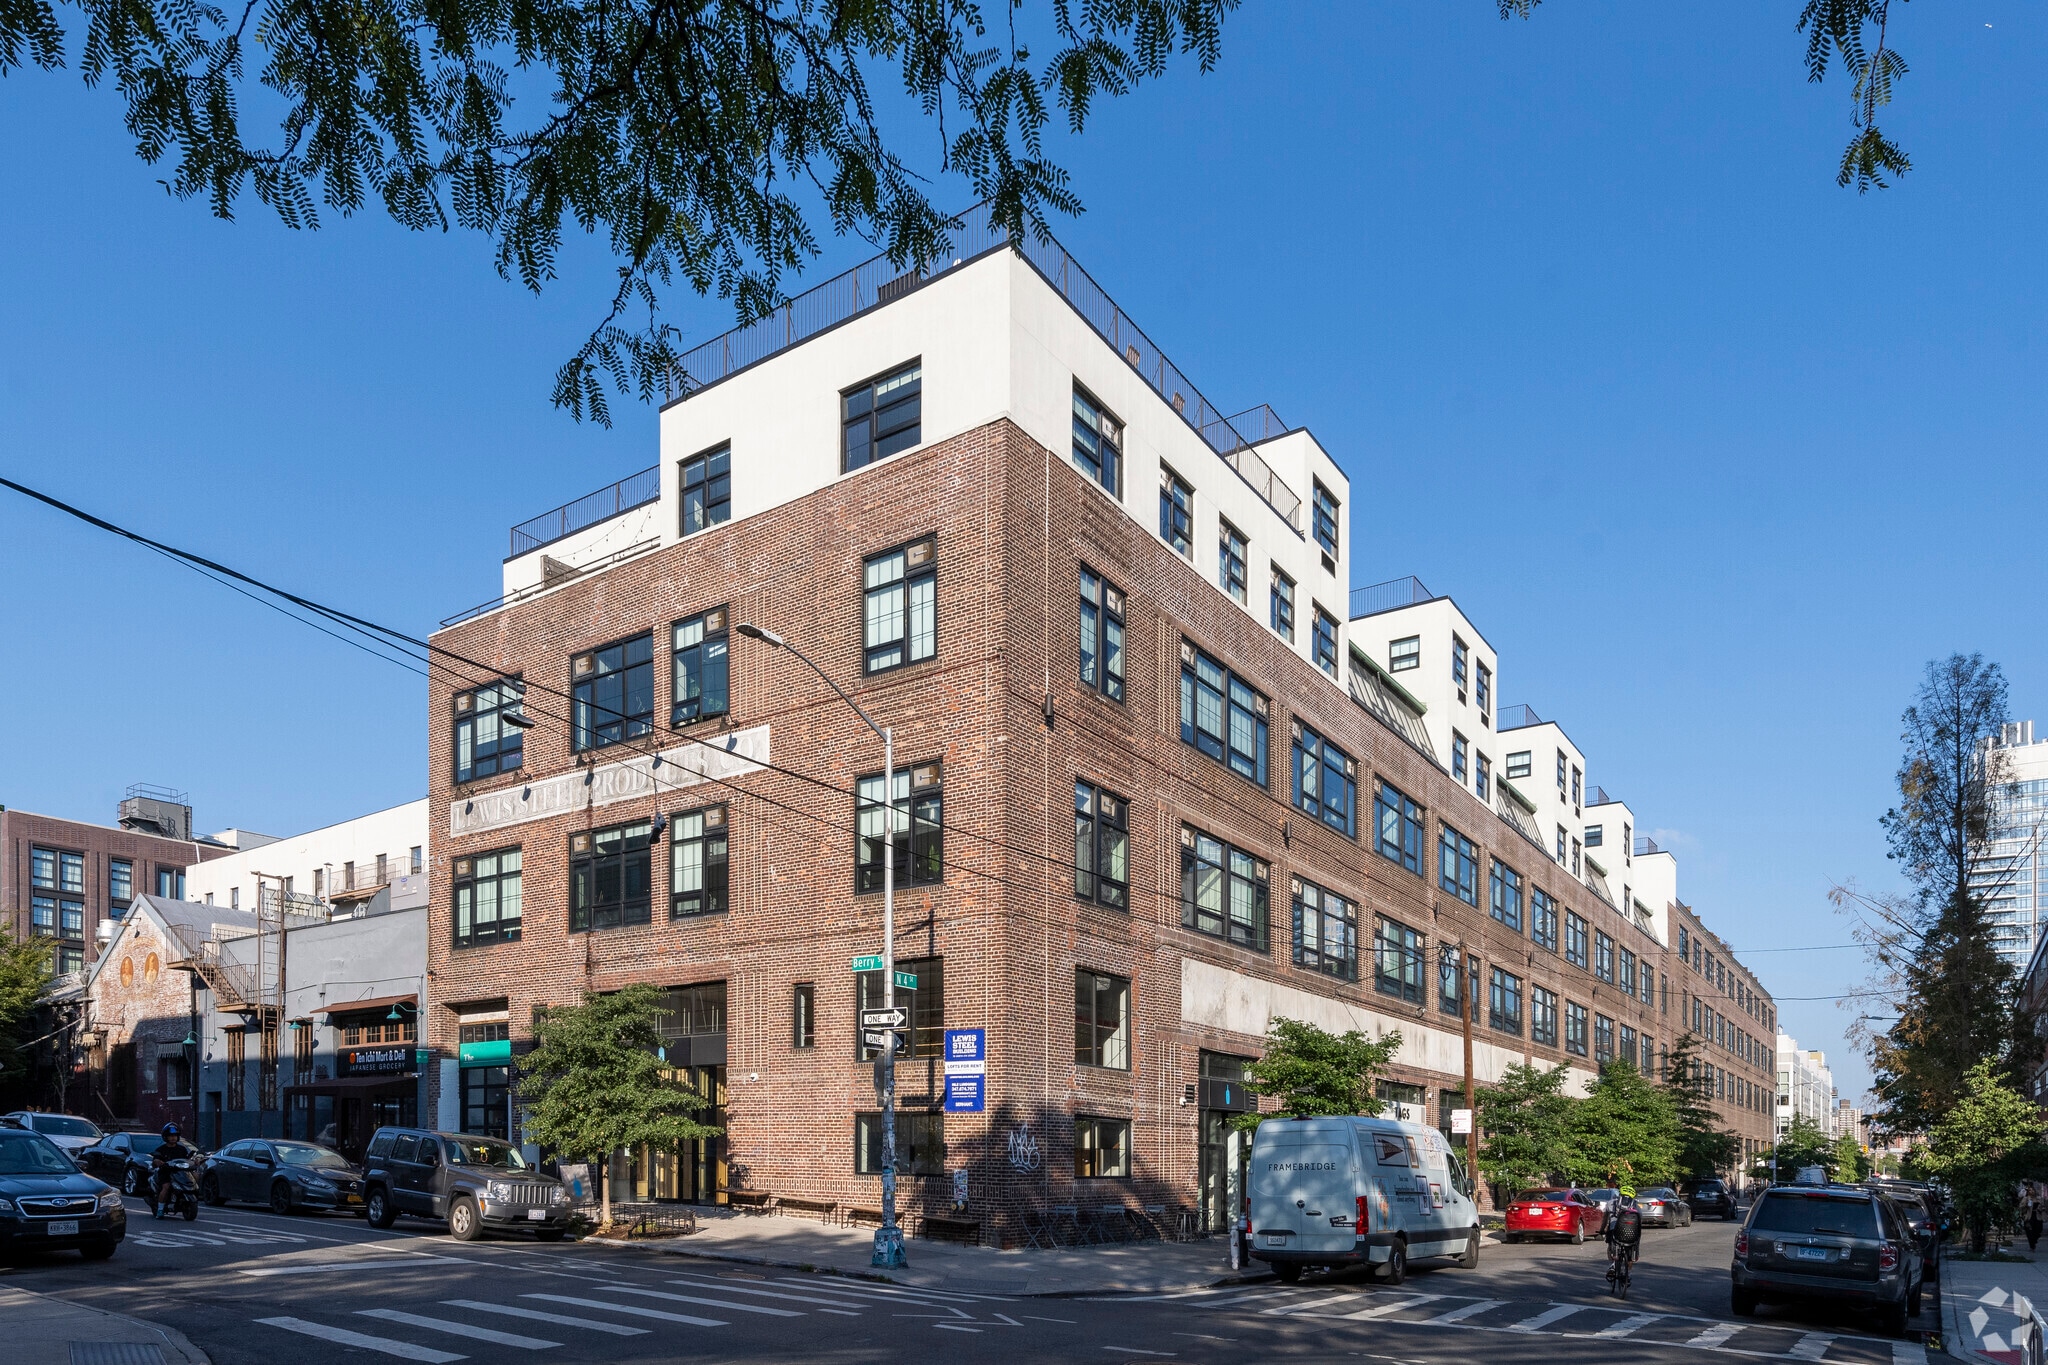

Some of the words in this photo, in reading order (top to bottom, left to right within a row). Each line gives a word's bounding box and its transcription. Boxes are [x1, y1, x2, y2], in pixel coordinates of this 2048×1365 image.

[853, 958, 875, 969] Berry
[896, 974, 902, 985] N
[903, 975, 908, 986] 4
[867, 1014, 882, 1024] ONE
[887, 1014, 901, 1022] WAY
[868, 1034, 882, 1044] ONE
[952, 1034, 977, 1043] LEWIS
[952, 1041, 977, 1049] STEEL
[356, 1052, 365, 1063] Ten
[365, 1051, 375, 1062] Ichi
[375, 1050, 388, 1062] Mart
[394, 1049, 406, 1061] Deli
[463, 1053, 475, 1062] The
[349, 1063, 376, 1071] JAPANESE
[378, 1062, 406, 1070] GROCERY
[1268, 1162, 1336, 1172] FRAMEBRIDGE
